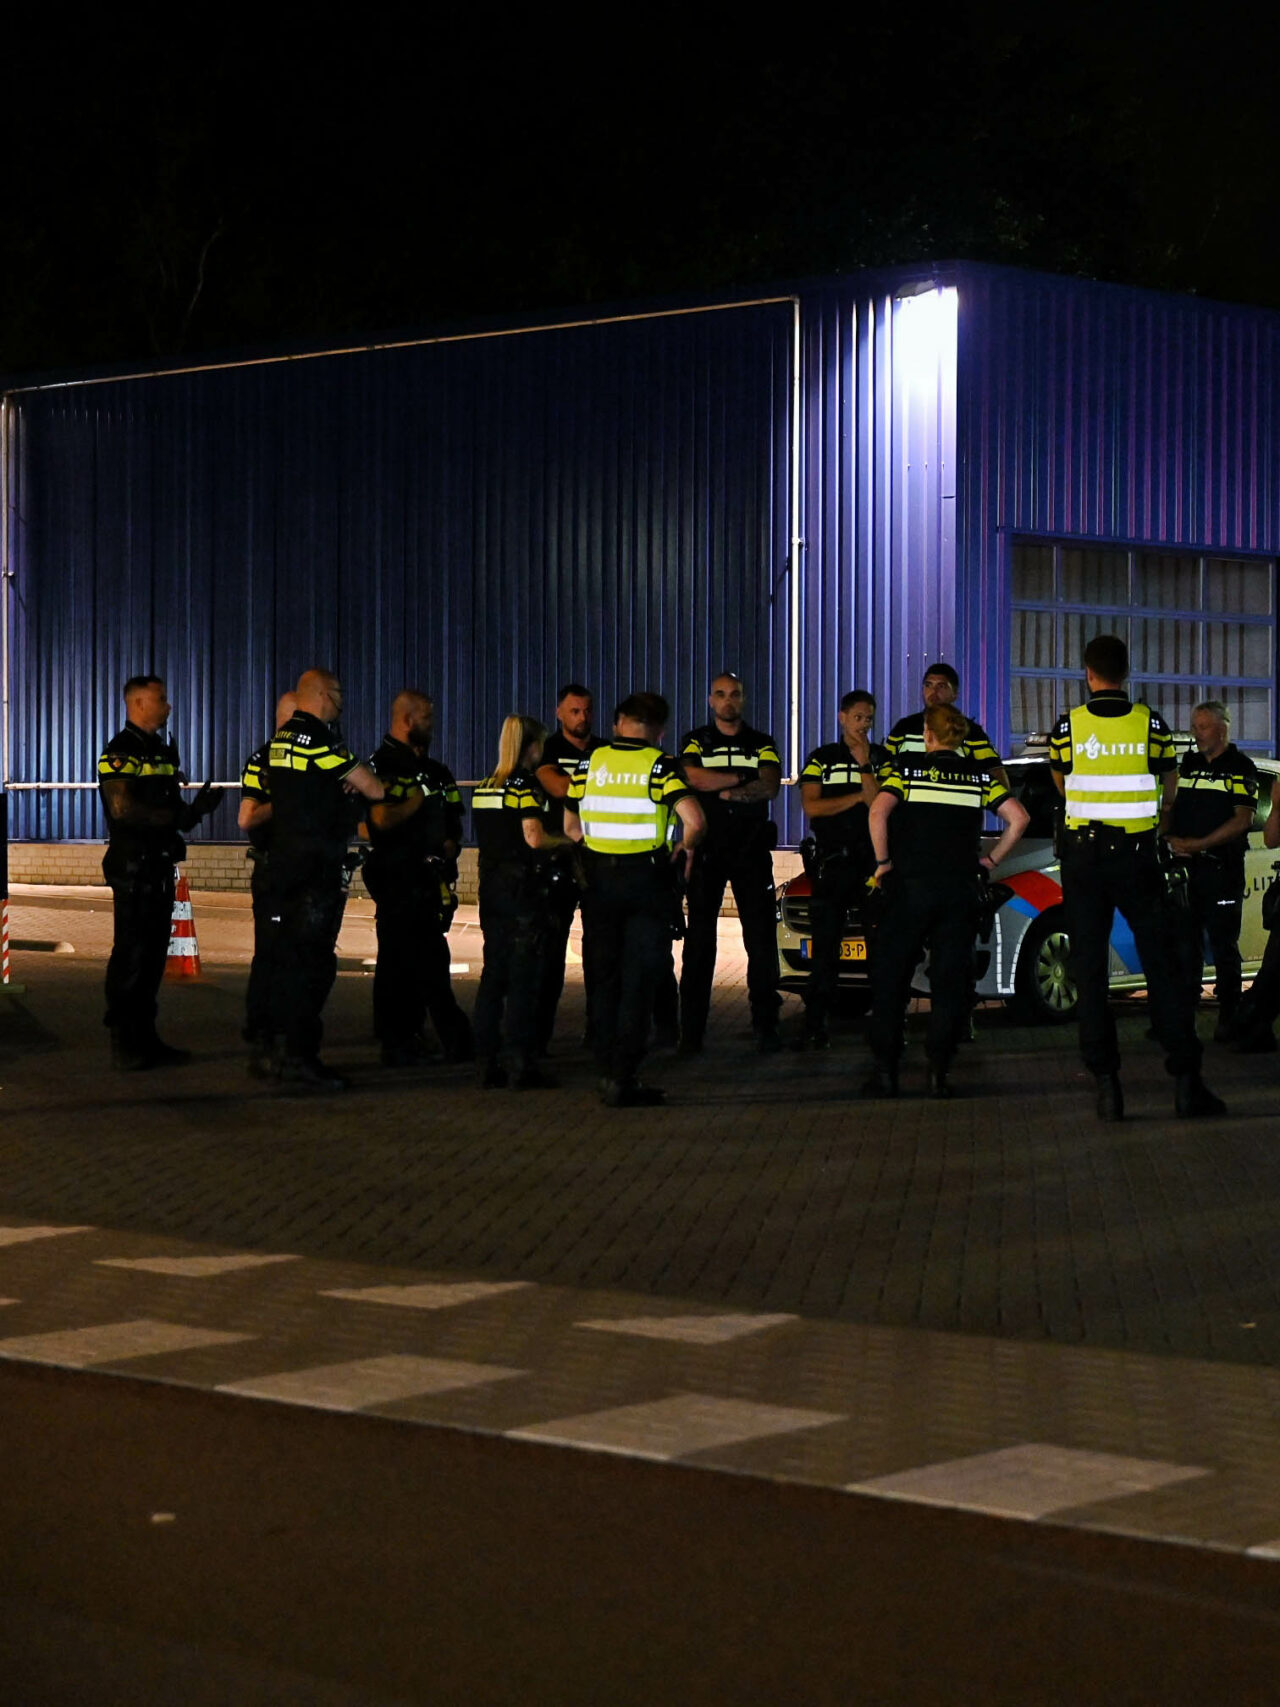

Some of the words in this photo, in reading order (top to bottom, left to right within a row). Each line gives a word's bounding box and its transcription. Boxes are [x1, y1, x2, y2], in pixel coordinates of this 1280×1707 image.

[1076, 733, 1145, 759] POLITIE
[589, 762, 648, 787] POLITIE
[922, 766, 973, 782] POLITIE
